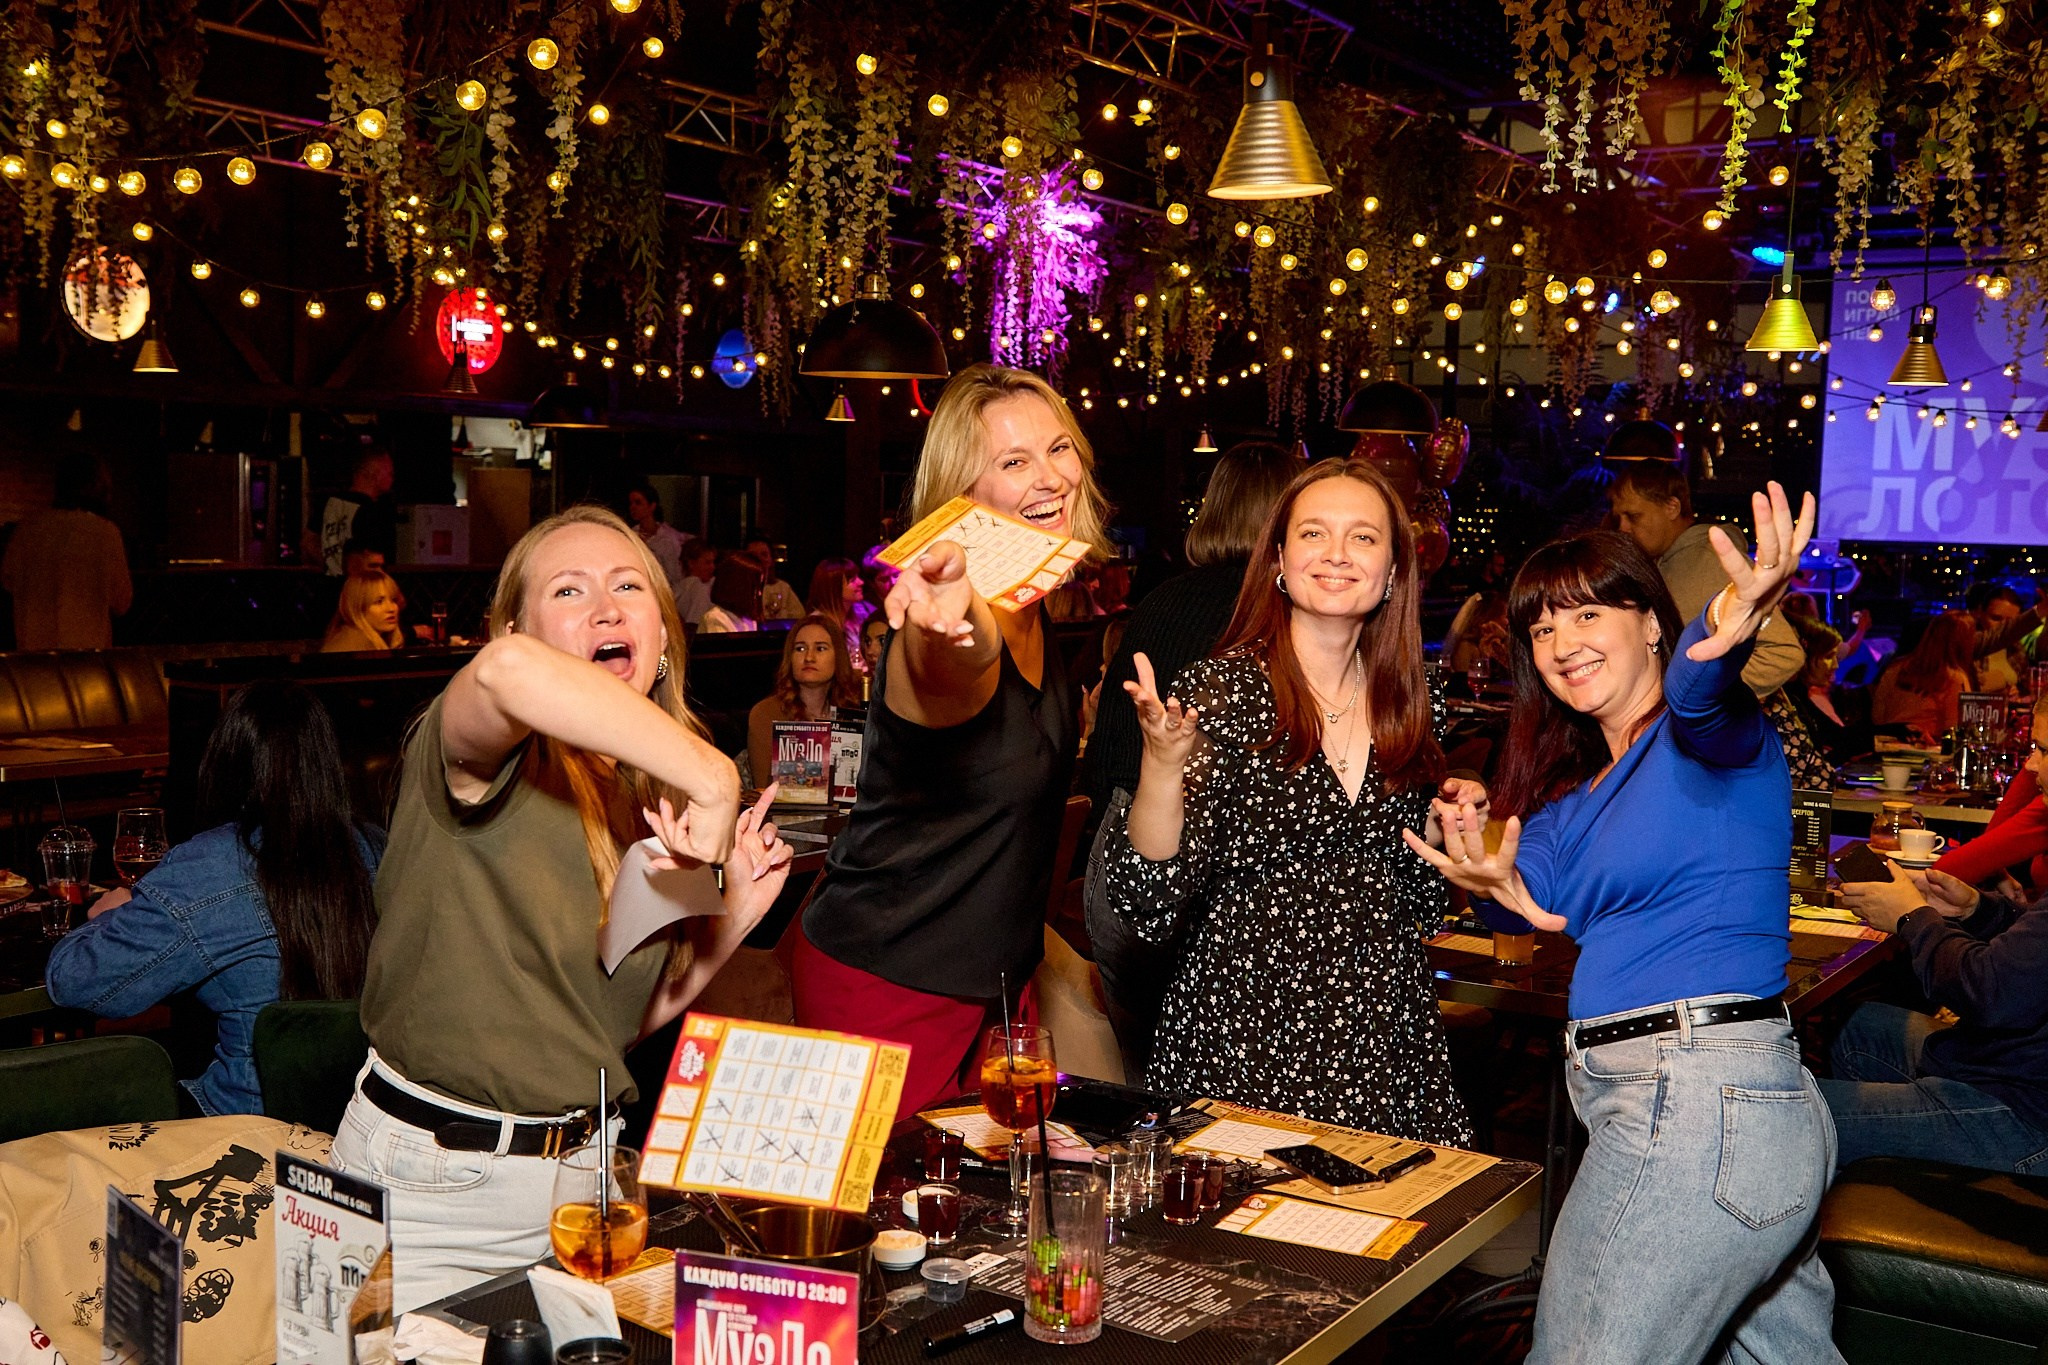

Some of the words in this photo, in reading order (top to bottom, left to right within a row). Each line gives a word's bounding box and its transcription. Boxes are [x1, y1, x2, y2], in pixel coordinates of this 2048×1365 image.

[1844, 306, 1900, 322] ИГРАЙ
[1872, 397, 2048, 471] МУ
[281, 1195, 340, 1241] Акция
[683, 1265, 739, 1289] КАЖДУЮ
[739, 1273, 796, 1298] СУББОТУ
[797, 1281, 807, 1299] В
[808, 1282, 848, 1305] 20:00
